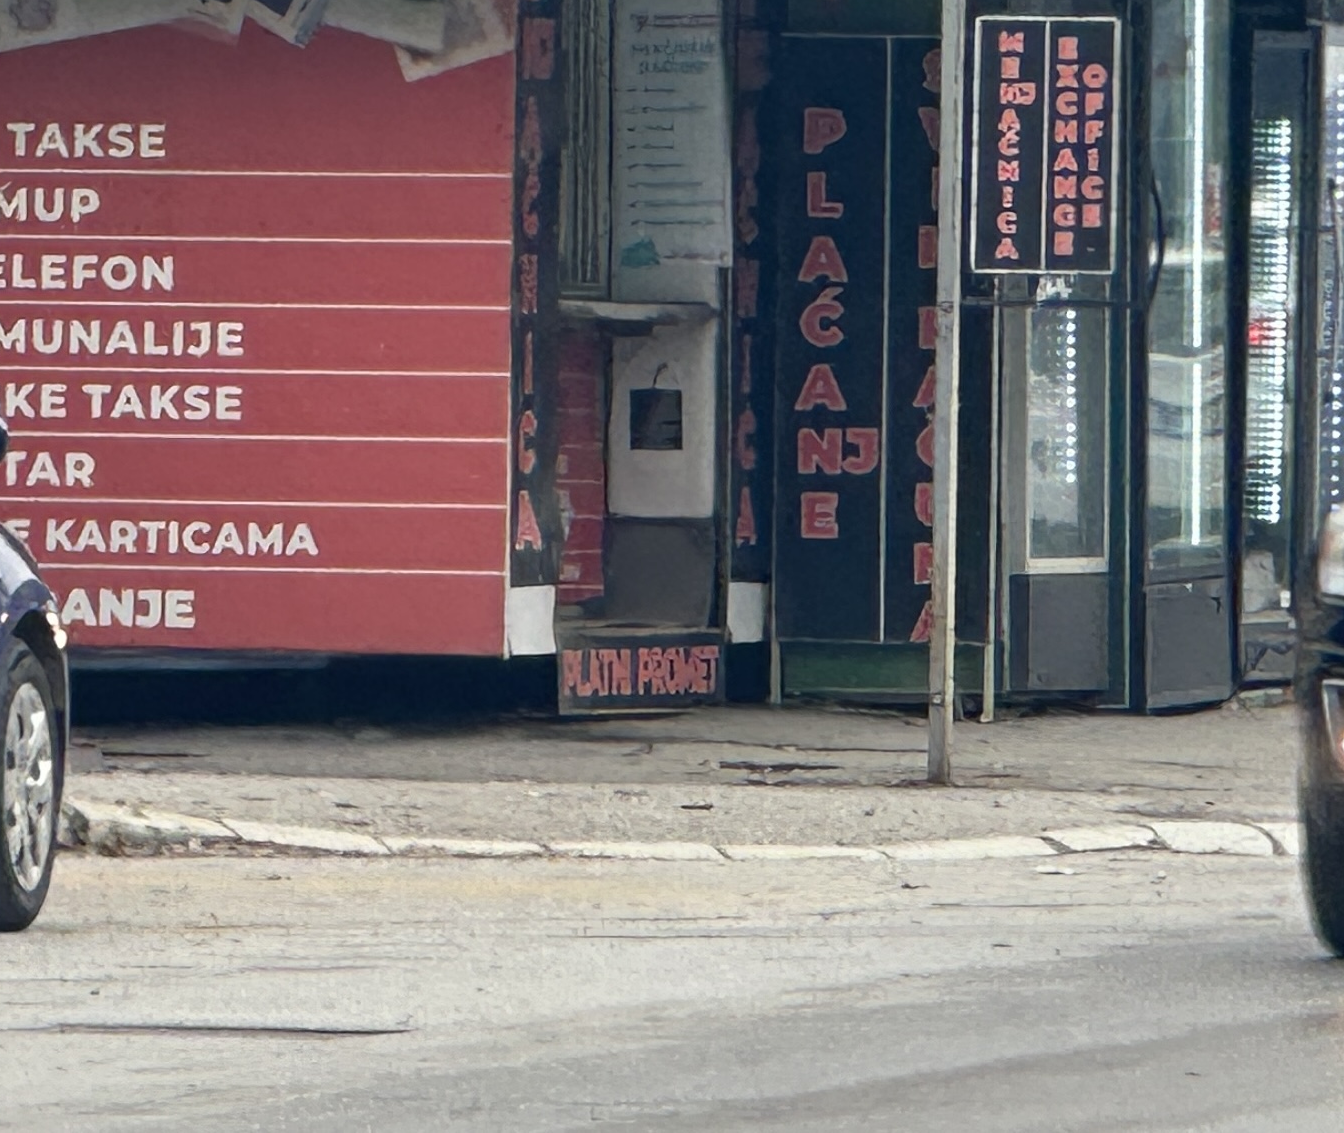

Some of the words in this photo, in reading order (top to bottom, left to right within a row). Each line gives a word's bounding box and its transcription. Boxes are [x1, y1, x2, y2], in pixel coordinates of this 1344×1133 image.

[7, 122, 167, 158] TAKSE
[82, 383, 243, 420] TAKSE
[46, 518, 319, 556] KARTICAMA
